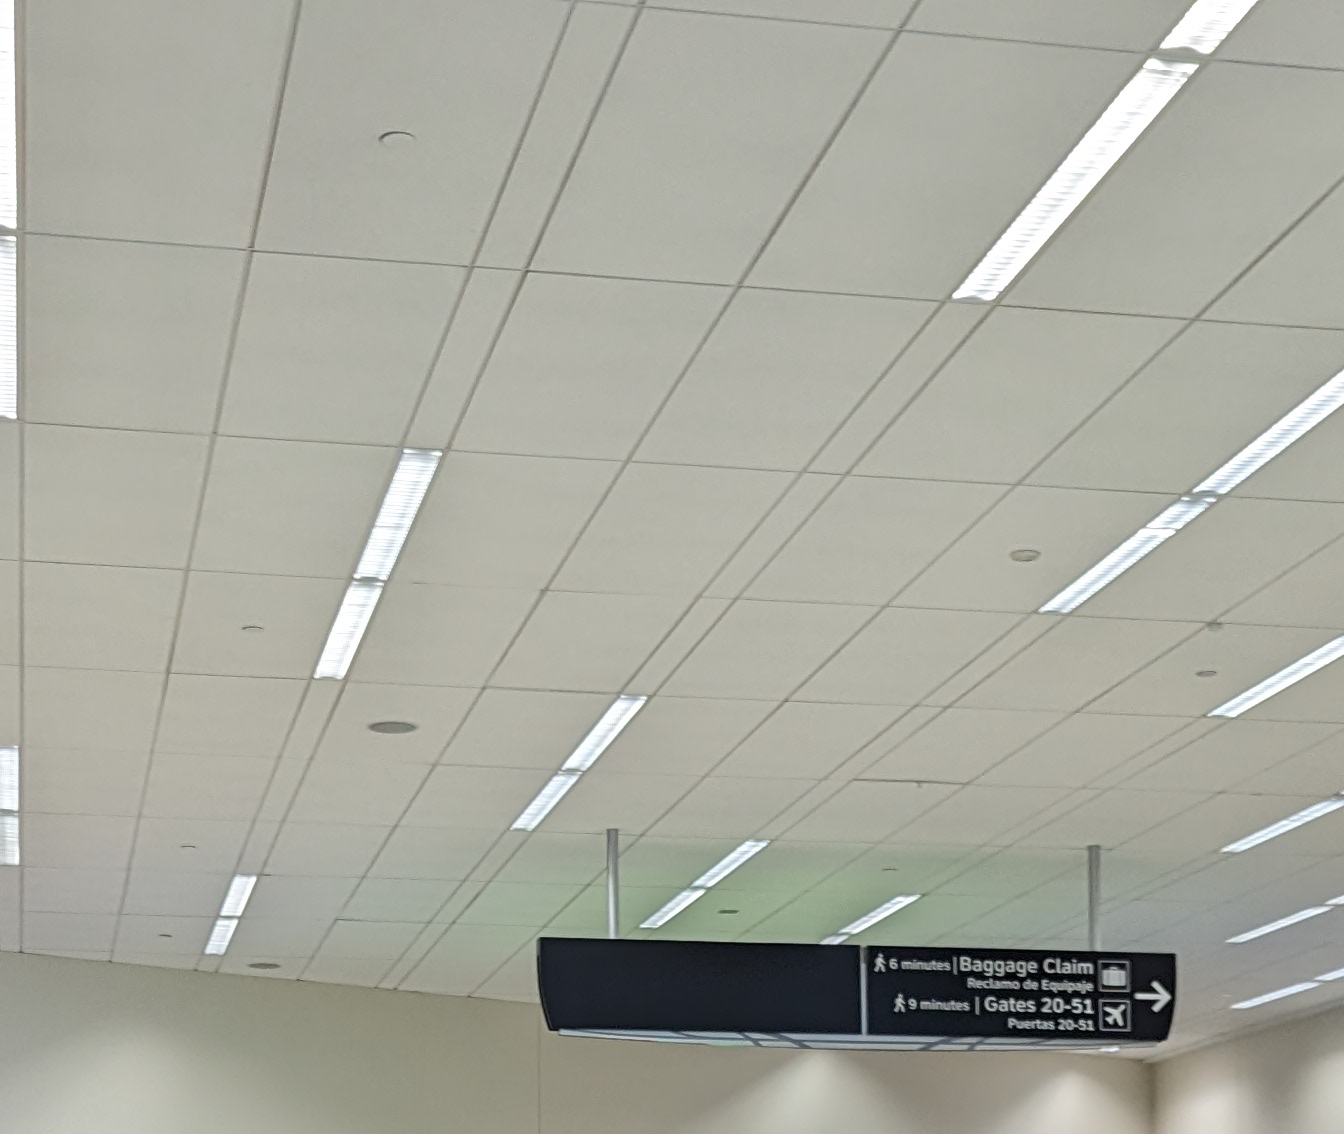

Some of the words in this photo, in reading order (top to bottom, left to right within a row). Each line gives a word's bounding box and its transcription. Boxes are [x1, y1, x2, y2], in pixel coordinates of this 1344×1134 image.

[888, 958, 898, 970] 6
[900, 960, 951, 971] minutes
[959, 956, 1038, 977] Baggage
[1043, 957, 1094, 974] Claim
[966, 977, 1021, 990] Reclamo
[1022, 979, 1039, 991] de
[1041, 979, 1094, 994] Equipaje
[907, 998, 917, 1010] 9
[919, 999, 970, 1011] minutes
[984, 997, 1036, 1012] Gates
[1040, 998, 1095, 1014] 20-51
[1007, 1018, 1055, 1030] Puertas
[1057, 1018, 1095, 1031] 20-51
